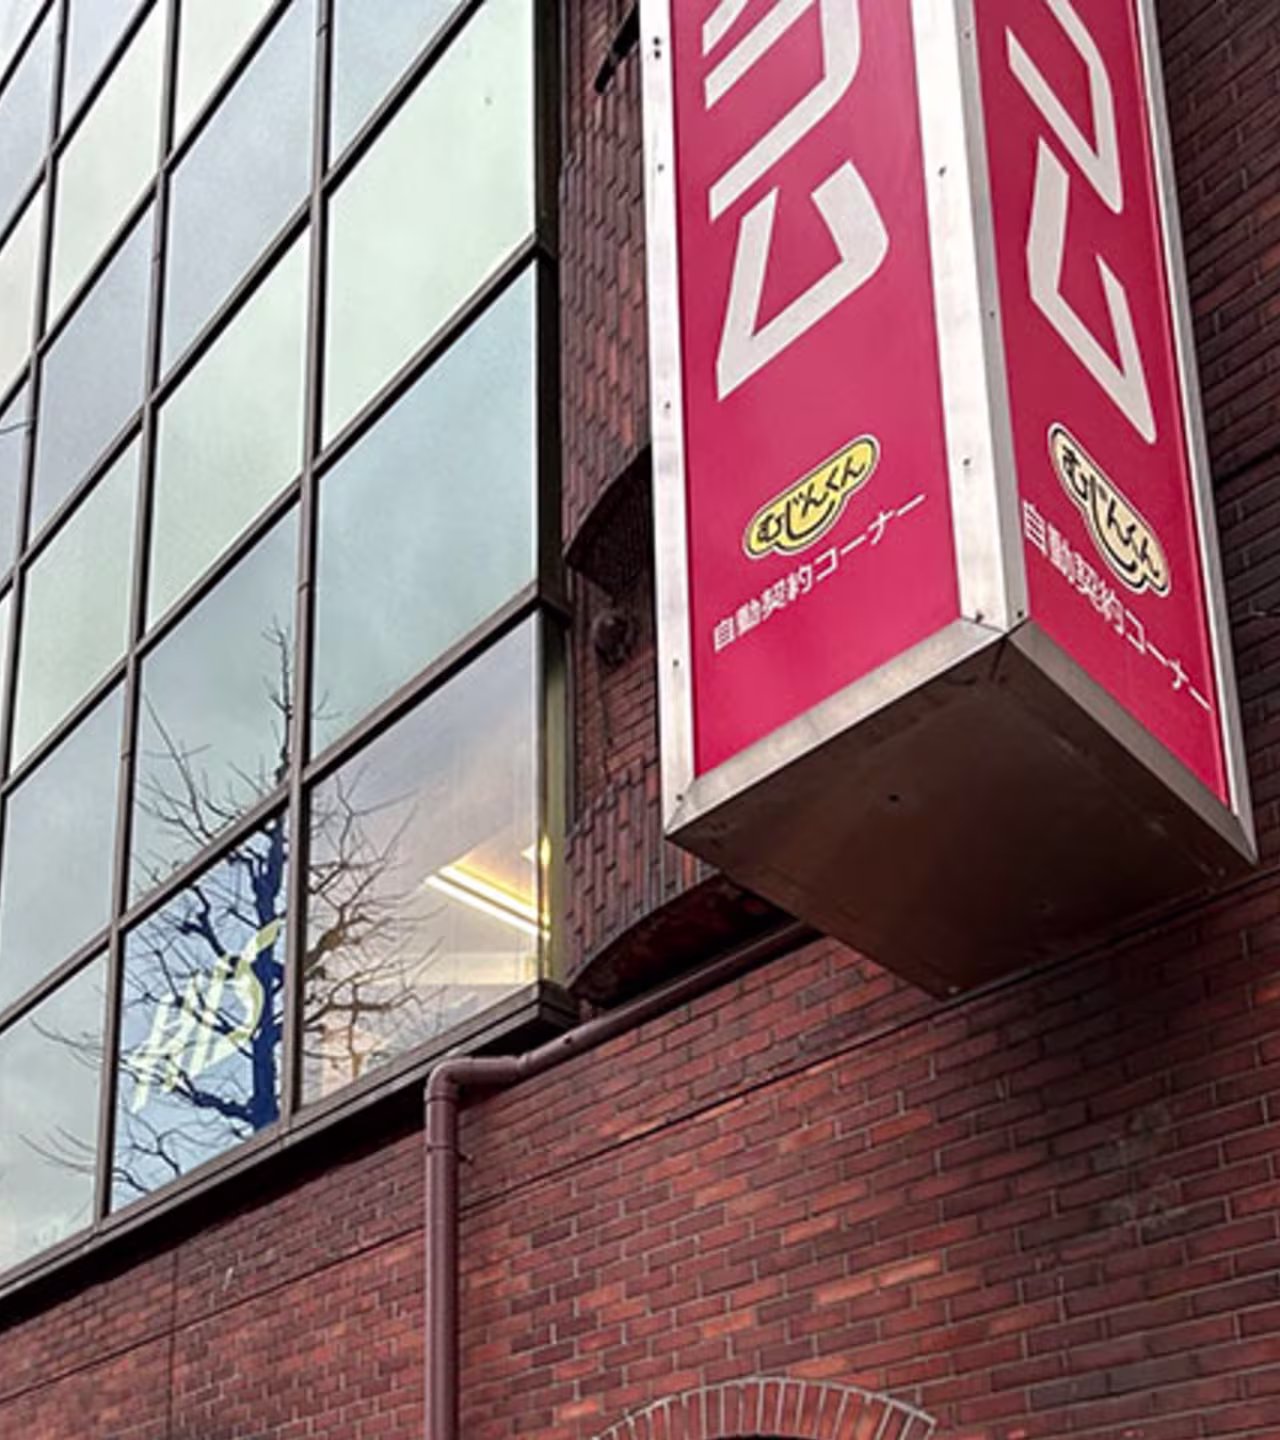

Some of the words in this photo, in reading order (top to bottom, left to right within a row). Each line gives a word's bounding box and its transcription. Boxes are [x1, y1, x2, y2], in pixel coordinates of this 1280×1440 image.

[703, 0, 889, 401] コム
[713, 494, 926, 653] 自動契約コーナー
[756, 456, 866, 542] むじんくん
[1060, 445, 1160, 579] むじんくん
[1023, 500, 1212, 711] 自動契約コーナー
